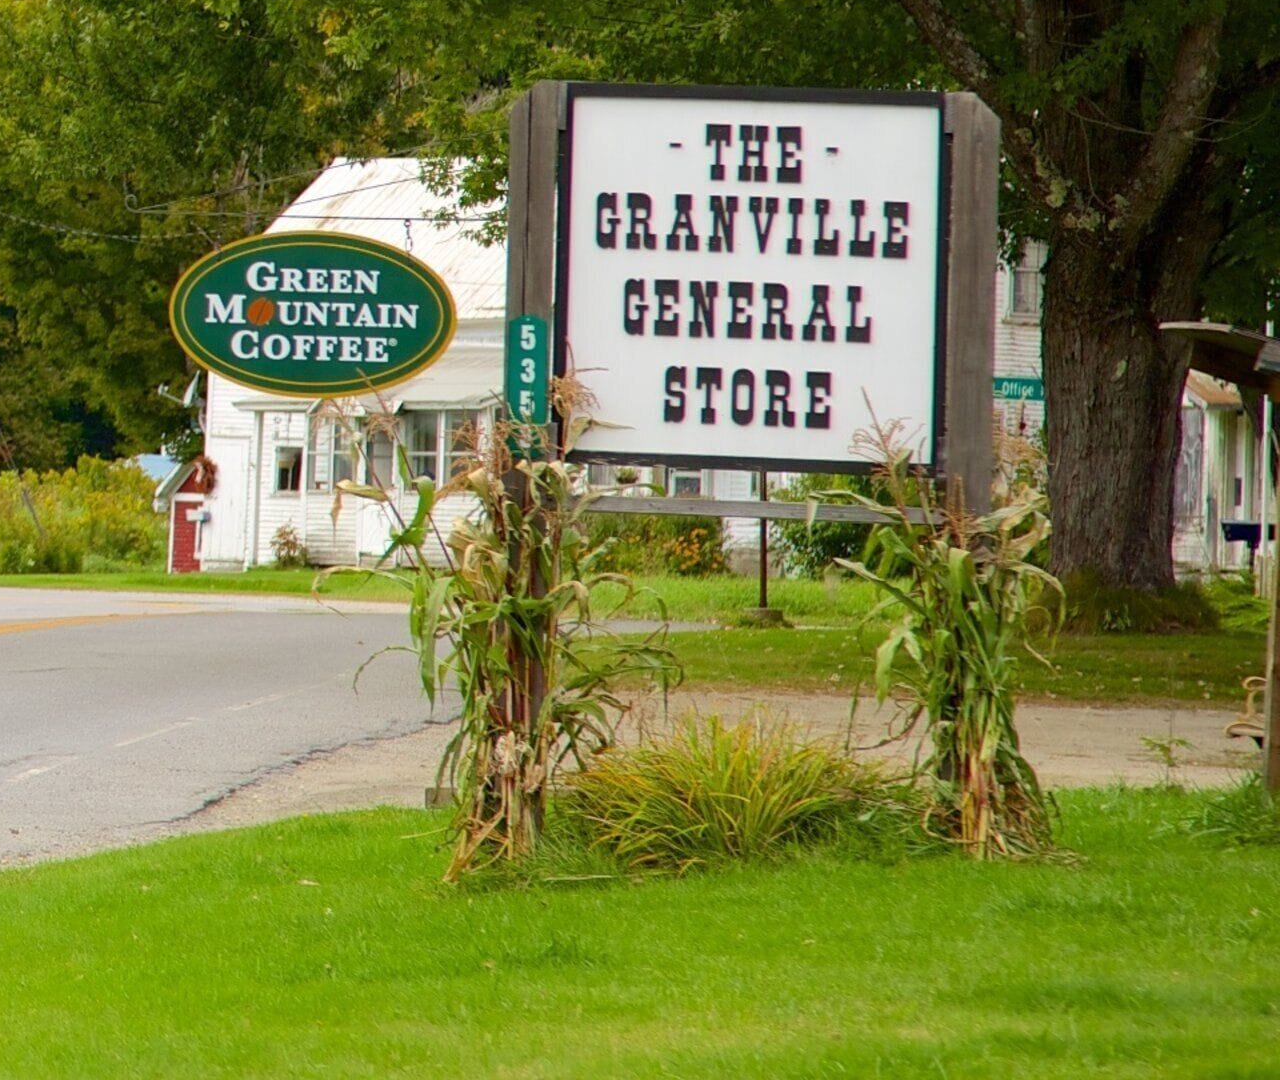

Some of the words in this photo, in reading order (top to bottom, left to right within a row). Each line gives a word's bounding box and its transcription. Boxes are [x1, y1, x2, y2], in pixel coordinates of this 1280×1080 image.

[705, 123, 803, 184] THE
[595, 191, 910, 260] GRANVILLE
[245, 261, 381, 295] GREEN
[623, 277, 872, 344] GENERAL
[663, 365, 833, 430] STORE
[1002, 381, 1034, 397] Office
